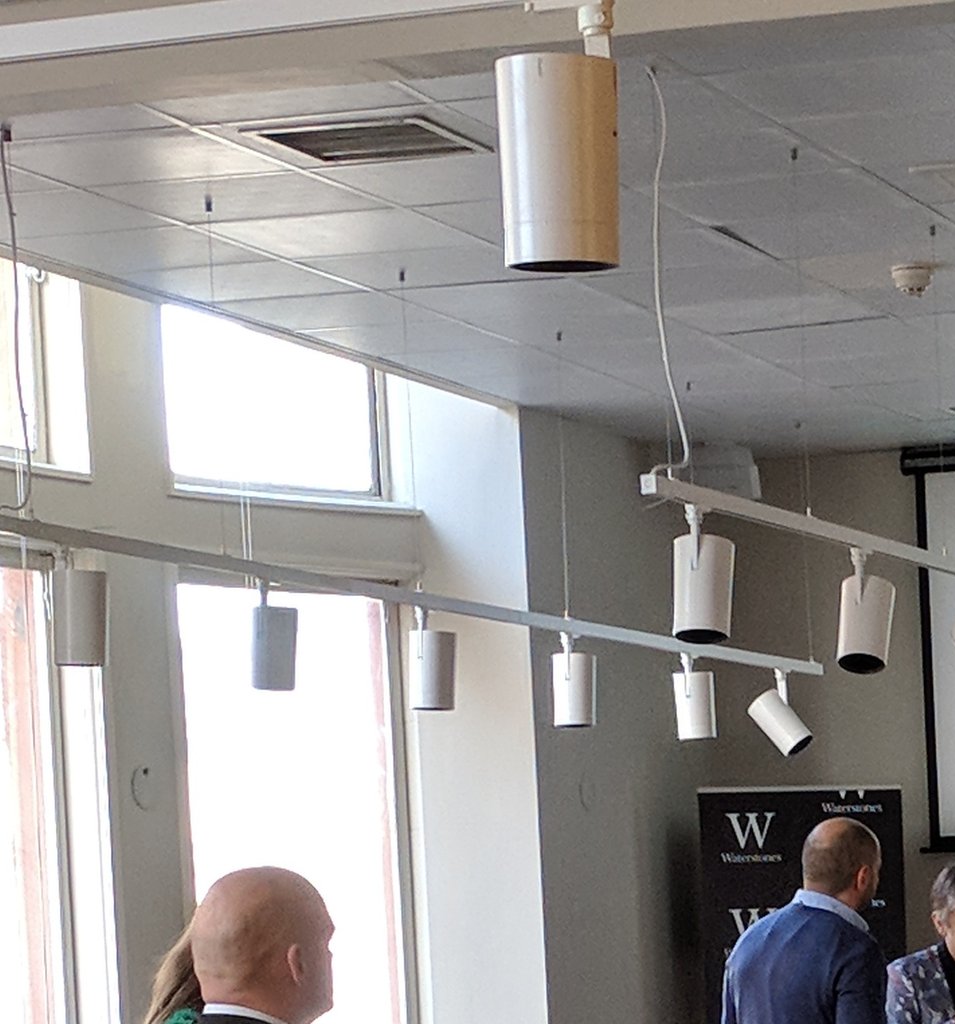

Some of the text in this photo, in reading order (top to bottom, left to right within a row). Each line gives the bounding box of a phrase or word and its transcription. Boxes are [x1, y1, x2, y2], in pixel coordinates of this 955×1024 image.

[821, 802, 883, 813] Waterstones
[725, 812, 776, 849] W
[720, 852, 782, 863] Waterstones
